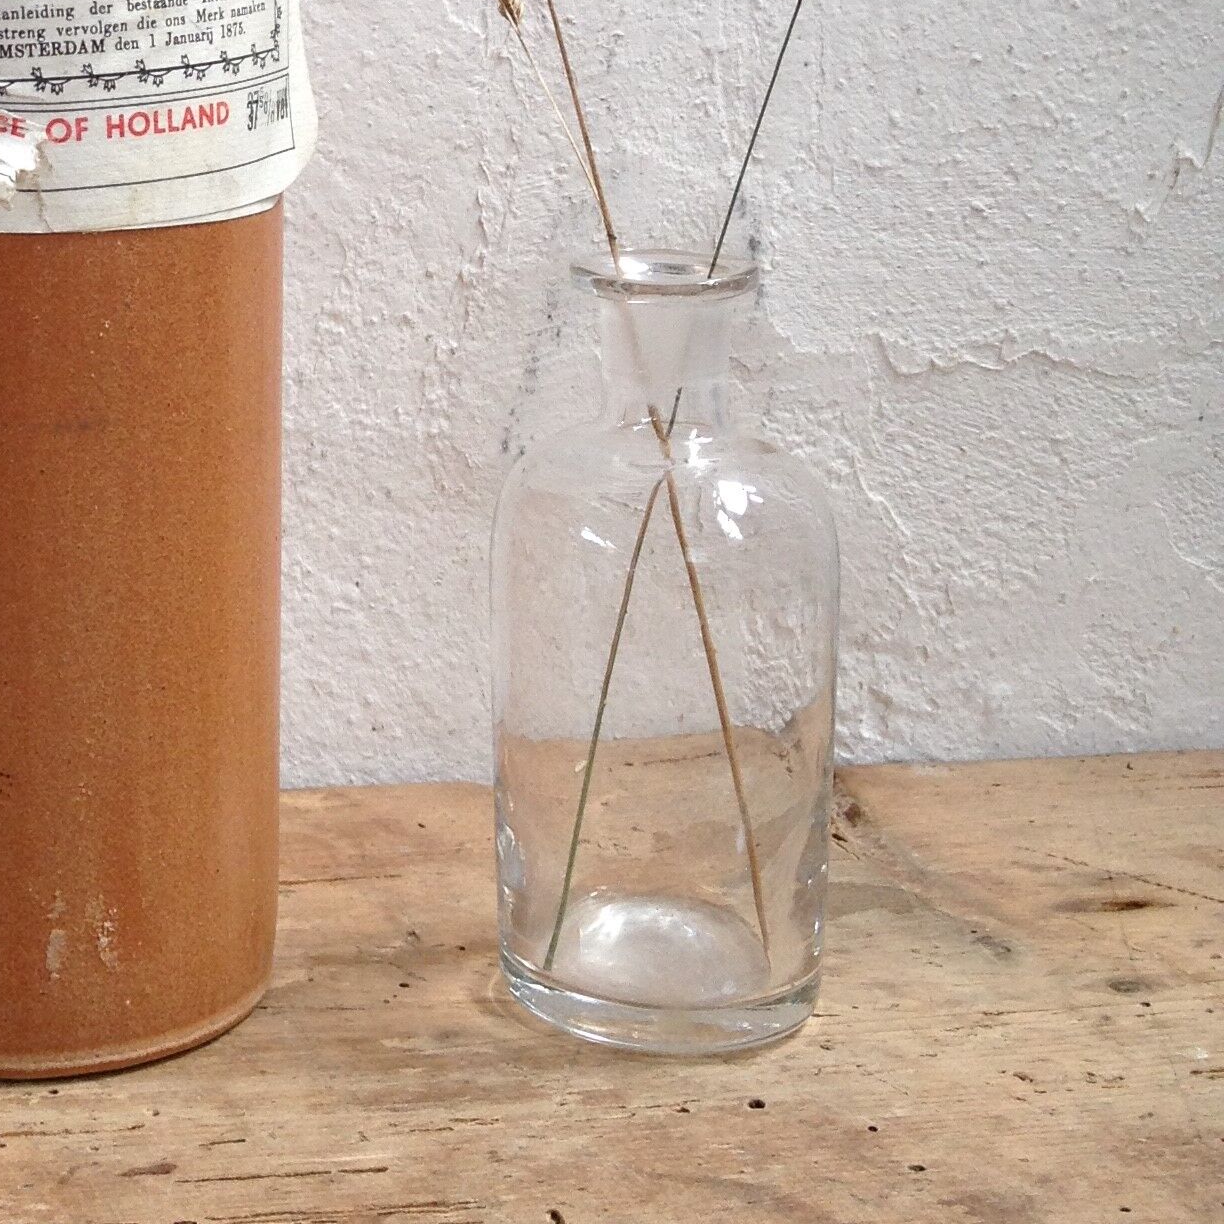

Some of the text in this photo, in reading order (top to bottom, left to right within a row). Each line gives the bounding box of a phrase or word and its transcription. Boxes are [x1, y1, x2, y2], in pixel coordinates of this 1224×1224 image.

[56, 19, 128, 37] vervolgen
[136, 14, 158, 30] die
[165, 15, 186, 27] ons
[196, 7, 224, 24] Merk
[230, 0, 266, 17] namaken
[89, 0, 113, 15] der
[115, 36, 139, 51] den
[149, 34, 157, 48] 1
[165, 26, 215, 46] Januarij
[45, 117, 89, 144] OF
[106, 101, 230, 139] HOLLAND
